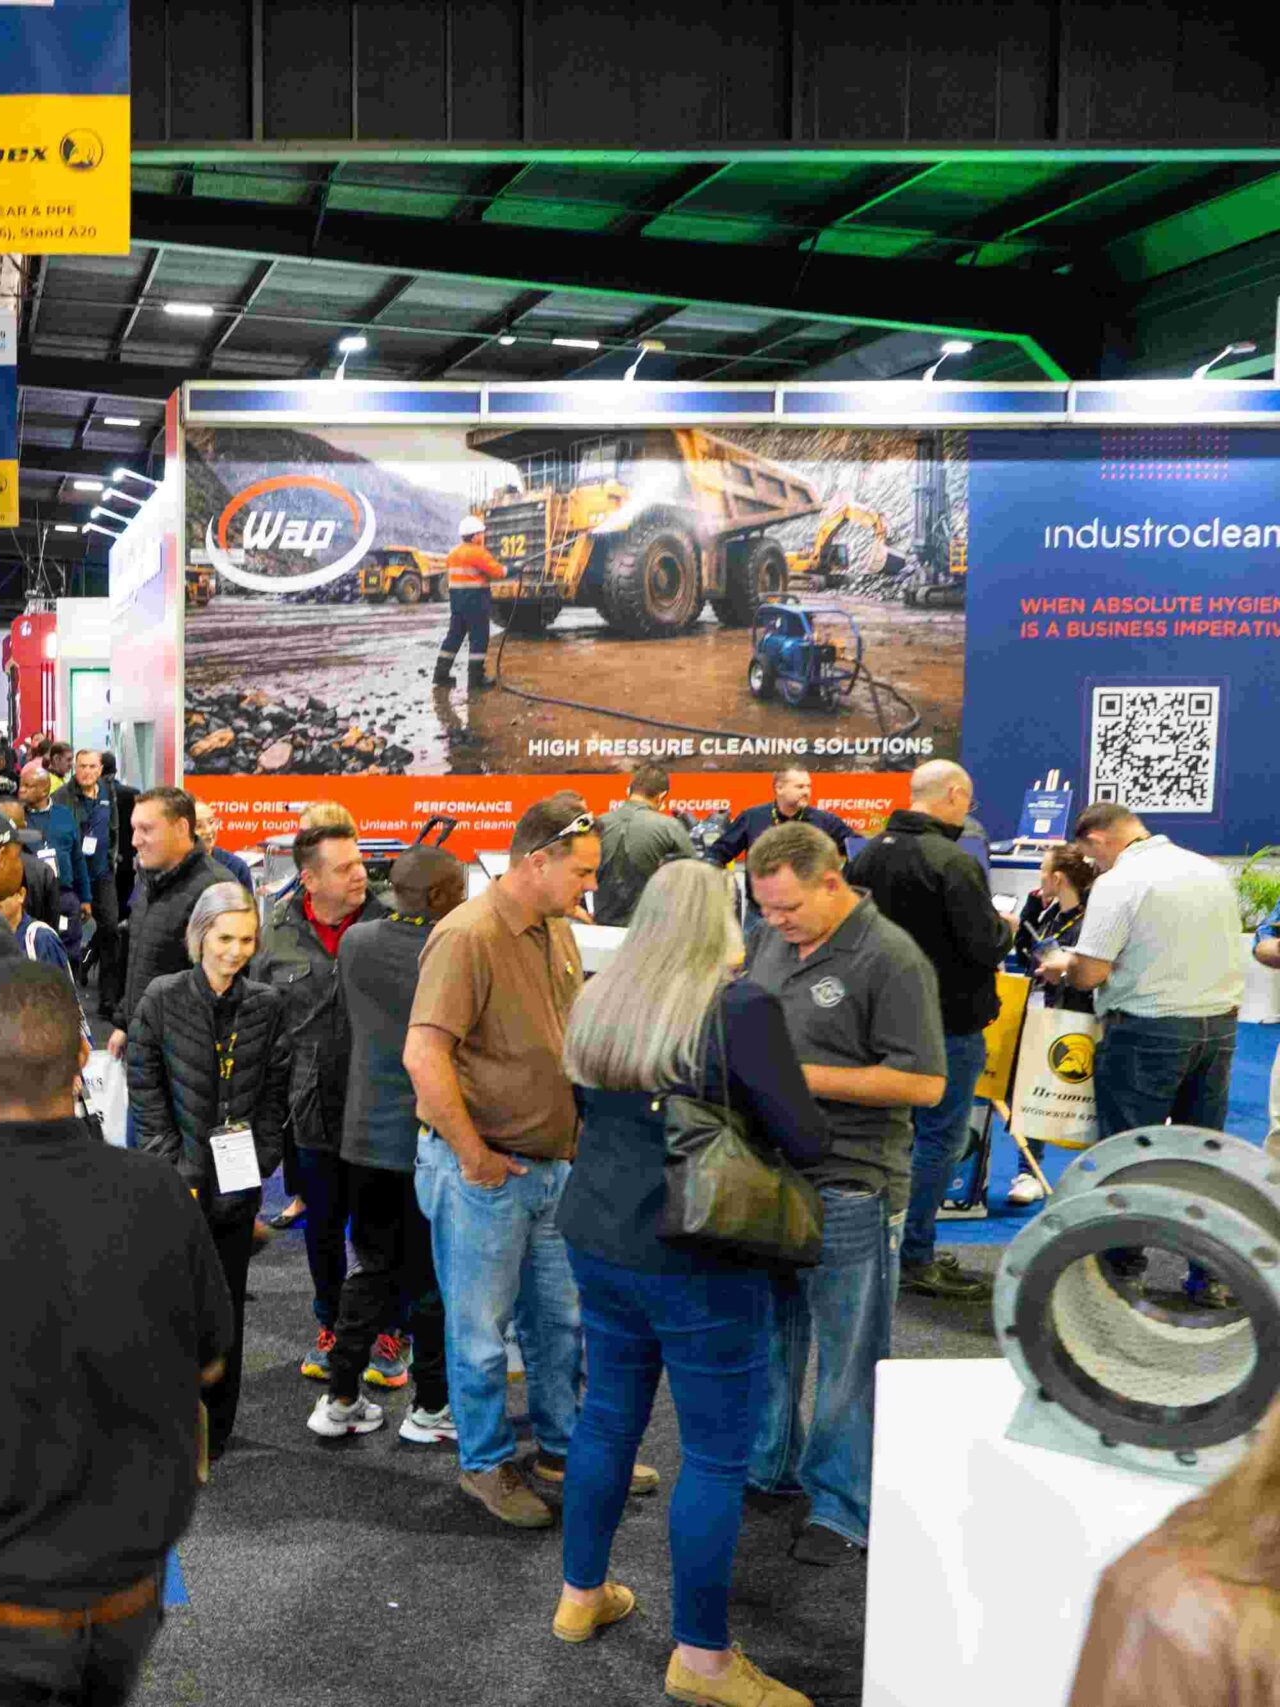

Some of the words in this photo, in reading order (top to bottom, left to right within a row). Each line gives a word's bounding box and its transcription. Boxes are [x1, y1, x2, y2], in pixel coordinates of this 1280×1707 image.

[31, 204, 41, 216] &
[46, 204, 75, 216] PPE
[20, 226, 64, 238] Stand
[68, 226, 97, 238] A20
[243, 511, 336, 556] Wap
[1044, 517, 1280, 549] industroclean
[500, 535, 527, 558] 312
[1020, 597, 1084, 614] WHEN
[1092, 596, 1202, 614] ABSOLUTE
[1020, 621, 1039, 638] IS
[1046, 621, 1059, 637] A
[1067, 620, 1167, 638] BUSINESS
[529, 739, 578, 756] HIGH
[586, 739, 694, 755] PRESSURE
[700, 738, 808, 755] CLEANING
[814, 737, 933, 755] SOLUTIONS
[209, 801, 249, 813] CTION
[414, 801, 512, 813] PERFORMANCE
[669, 799, 730, 812] FOCUSED
[817, 799, 892, 810] EFFICIENCY
[227, 820, 259, 833] away
[360, 819, 408, 831] Unleash
[1032, 1086, 1096, 1104] Drome
